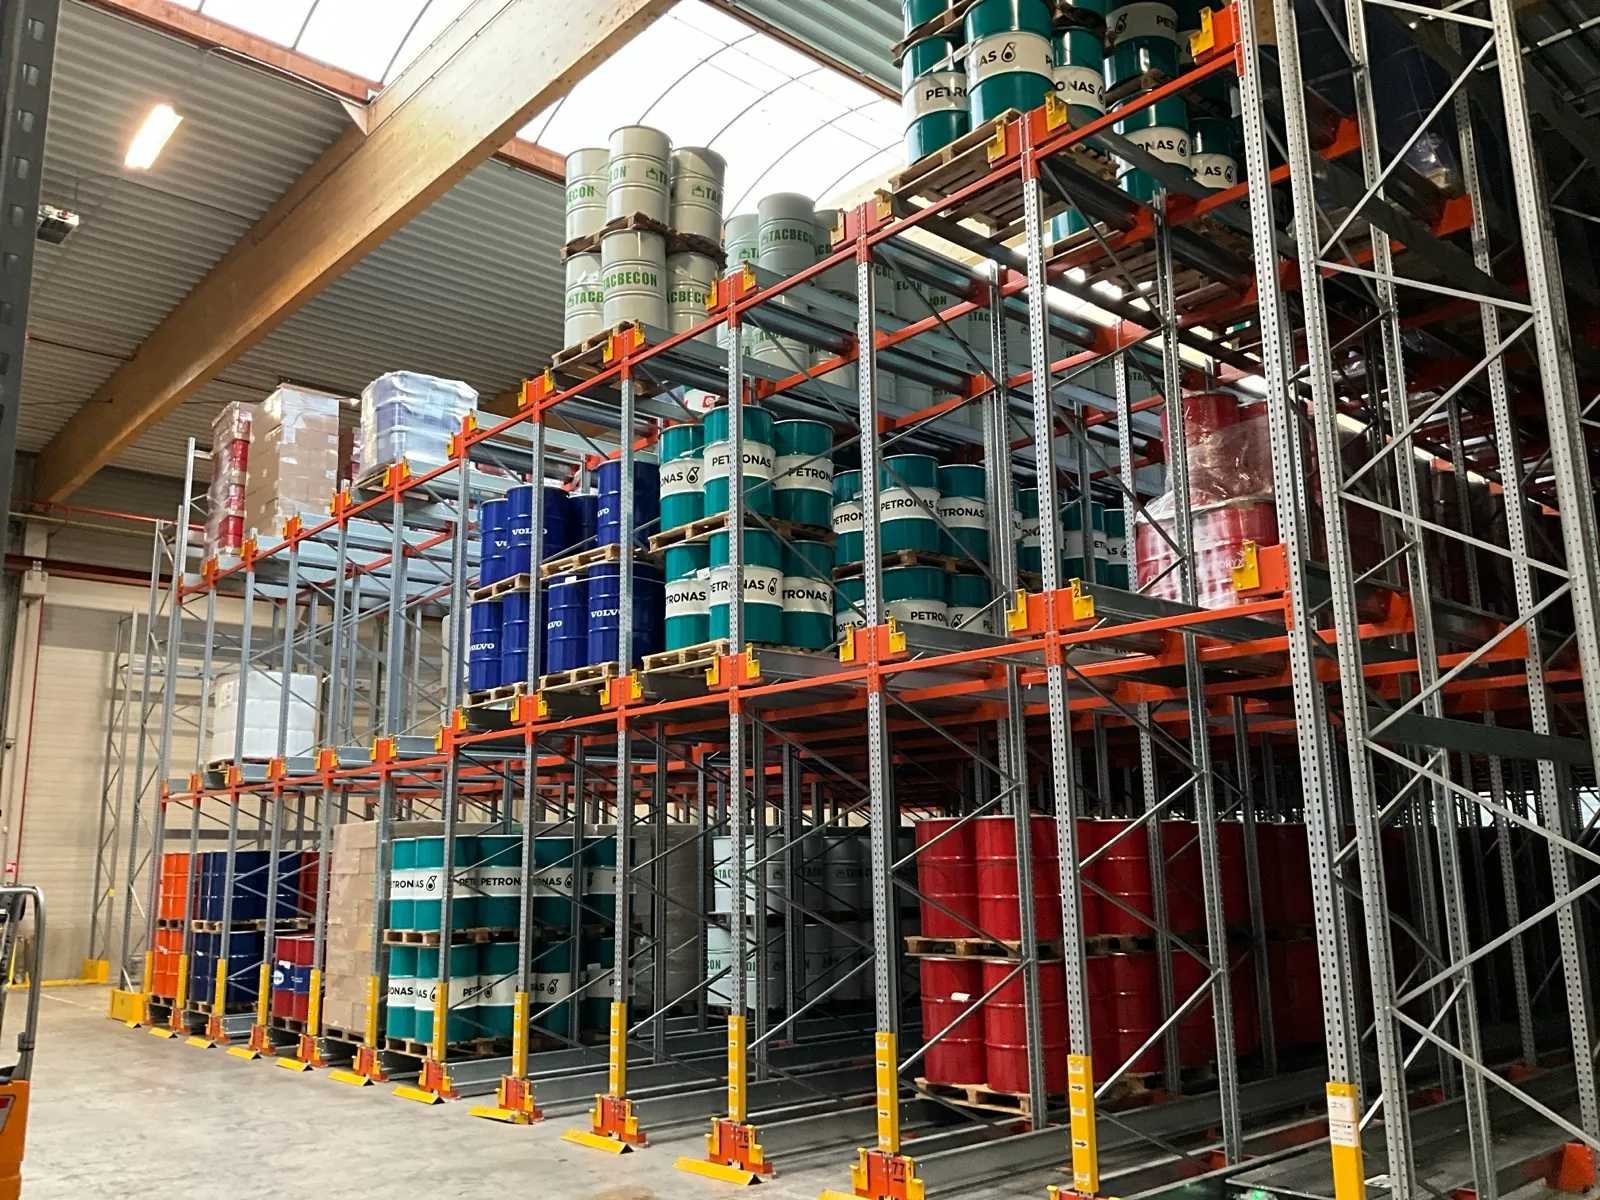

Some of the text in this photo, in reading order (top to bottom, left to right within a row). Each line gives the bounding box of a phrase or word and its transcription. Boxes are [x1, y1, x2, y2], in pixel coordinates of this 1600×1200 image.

[712, 454, 772, 469] PETONAS
[512, 528, 547, 536] VOLO
[711, 579, 765, 593] ETRNAS
[591, 609, 620, 618] VOLV
